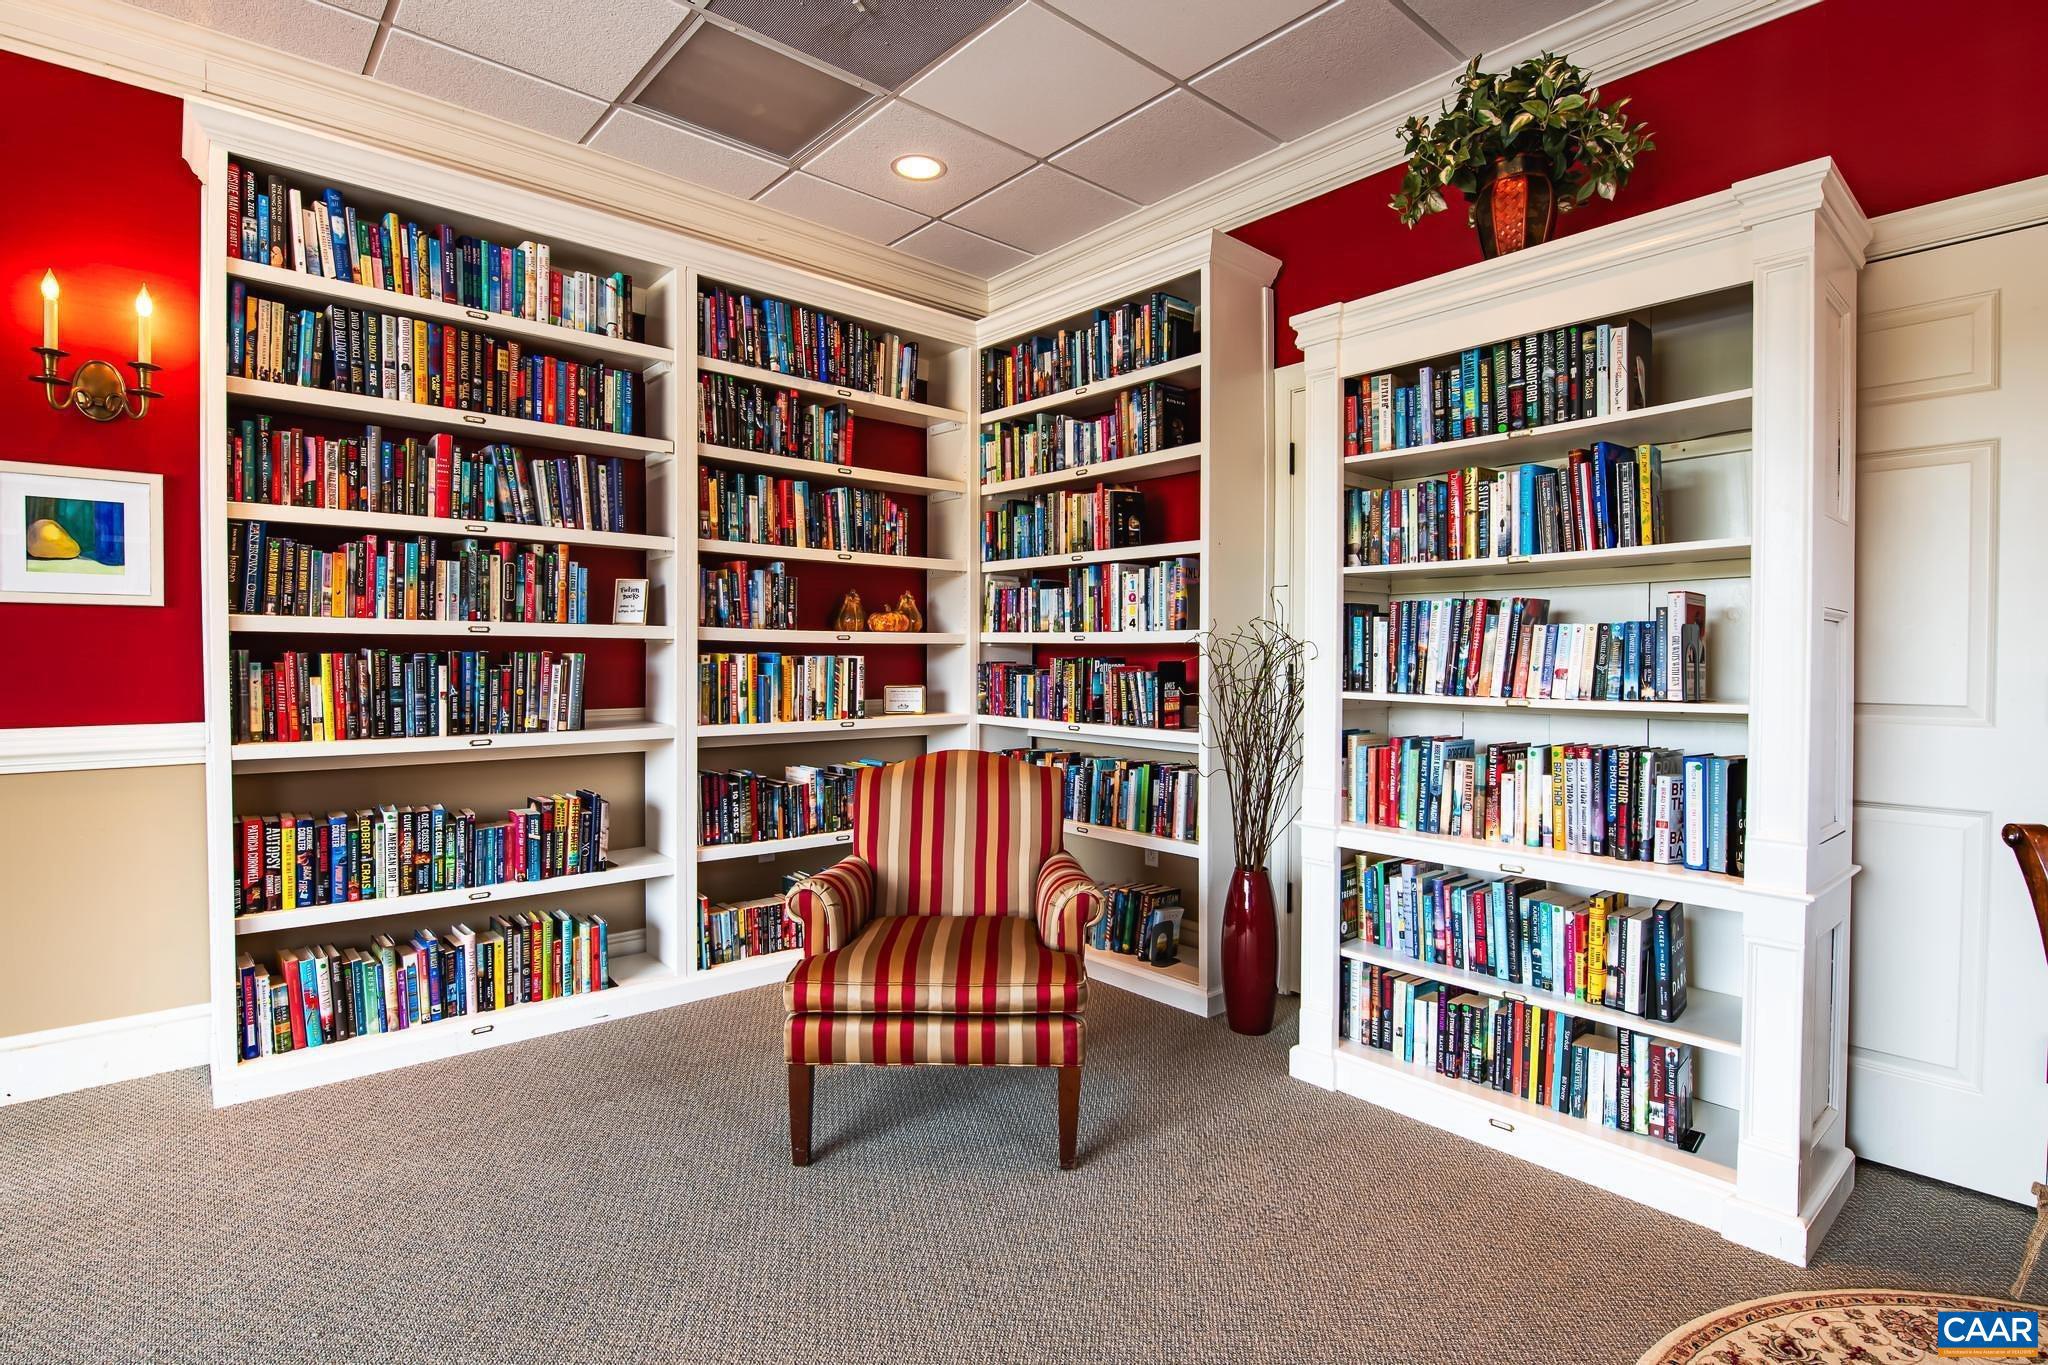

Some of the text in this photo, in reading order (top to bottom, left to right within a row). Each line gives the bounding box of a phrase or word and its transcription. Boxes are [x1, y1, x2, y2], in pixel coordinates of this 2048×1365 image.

[228, 170, 239, 247] INSIDE MAN JEFF ABBOTT
[333, 308, 347, 362] DAVID BALDACCI
[351, 311, 361, 358] DAVID BALDACCI
[368, 316, 377, 362] DAVID BALDACCI
[385, 317, 394, 333] DAVID
[402, 319, 411, 363] DAVID BALDACCI
[460, 350, 469, 379] BALDACCI
[1464, 356, 1472, 388] SANDFORD
[1511, 350, 1521, 379] SANDFORD
[1525, 336, 1538, 403] OHN SANDFORD
[1497, 385, 1507, 423] BROKEN PREY
[507, 465, 515, 483] BOX
[1478, 485, 1489, 511] SILVA
[229, 555, 239, 583] INFERNO
[247, 524, 260, 612] DAN BROWN ORIGIN
[267, 548, 279, 596] SANDRA BROWN
[285, 547, 295, 594] SANDRA BROWN
[299, 550, 309, 591] SANDRA BROWN
[1475, 601, 1483, 630] DANIELLE
[1511, 614, 1519, 637] DANIELLE
[1600, 635, 1608, 653] DANIELLE
[1672, 635, 1681, 686] GIRL WAITS WITH GUN
[1489, 747, 1497, 763] BRAD
[1553, 762, 1564, 806] BRAD THOR
[1566, 784, 1575, 804] THOR
[1580, 784, 1589, 804] THOR
[1618, 752, 1629, 804] BRAD THOR
[1430, 801, 1438, 822] TRAGIC
[266, 828, 280, 869] AUTOPSY
[297, 827, 305, 851] COULTER
[403, 814, 412, 858] CLIVE CUSSLER
[421, 814, 430, 853] CLIVE CUSSLER
[434, 833, 443, 856] CUSSLER
[570, 828, 578, 851] DEAVER
[247, 825, 259, 884] PATRICIA CORNWELL
[360, 820, 371, 889] ROBERT CRAIS
[387, 832, 397, 882] AMERICAN DIRT
[303, 866, 311, 880] BACK
[1524, 1009, 1532, 1033] Exploded
[1620, 1030, 1629, 1045] TOM
[1620, 1045, 1629, 1067] YOUNG
[1620, 1087, 1630, 1121] WARRIORS
